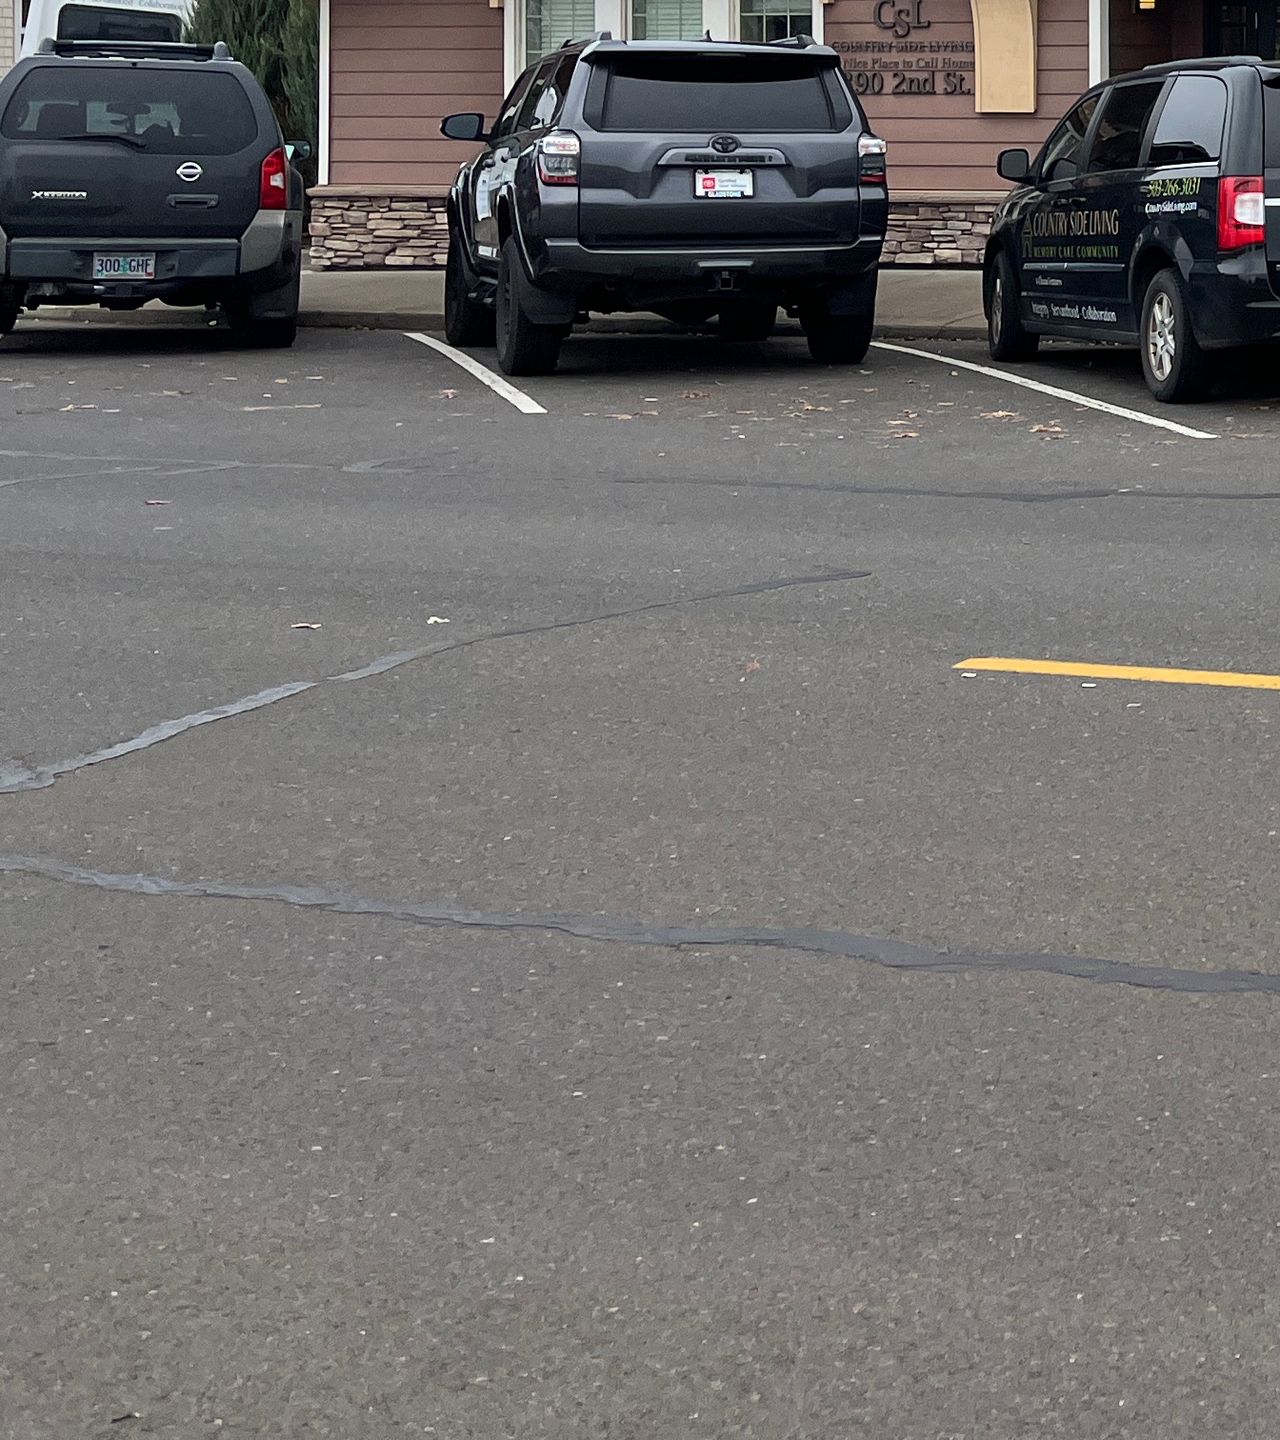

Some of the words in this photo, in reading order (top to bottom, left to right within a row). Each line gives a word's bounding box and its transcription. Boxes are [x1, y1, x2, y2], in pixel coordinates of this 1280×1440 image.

[873, 0, 932, 38] CSL
[831, 41, 894, 54] COUNTRY
[895, 41, 928, 54] SIDE
[929, 41, 975, 54] LIVING
[872, 57, 899, 69] Place
[902, 57, 914, 69] to
[915, 57, 939, 69] Call
[892, 70, 937, 95] 2nd
[944, 71, 971, 95] St.
[1033, 210, 1069, 237] COUNTRY
[1089, 208, 1119, 236] LIVING
[1076, 245, 1119, 258] COMMUNITY
[96, 258, 120, 273] 300
